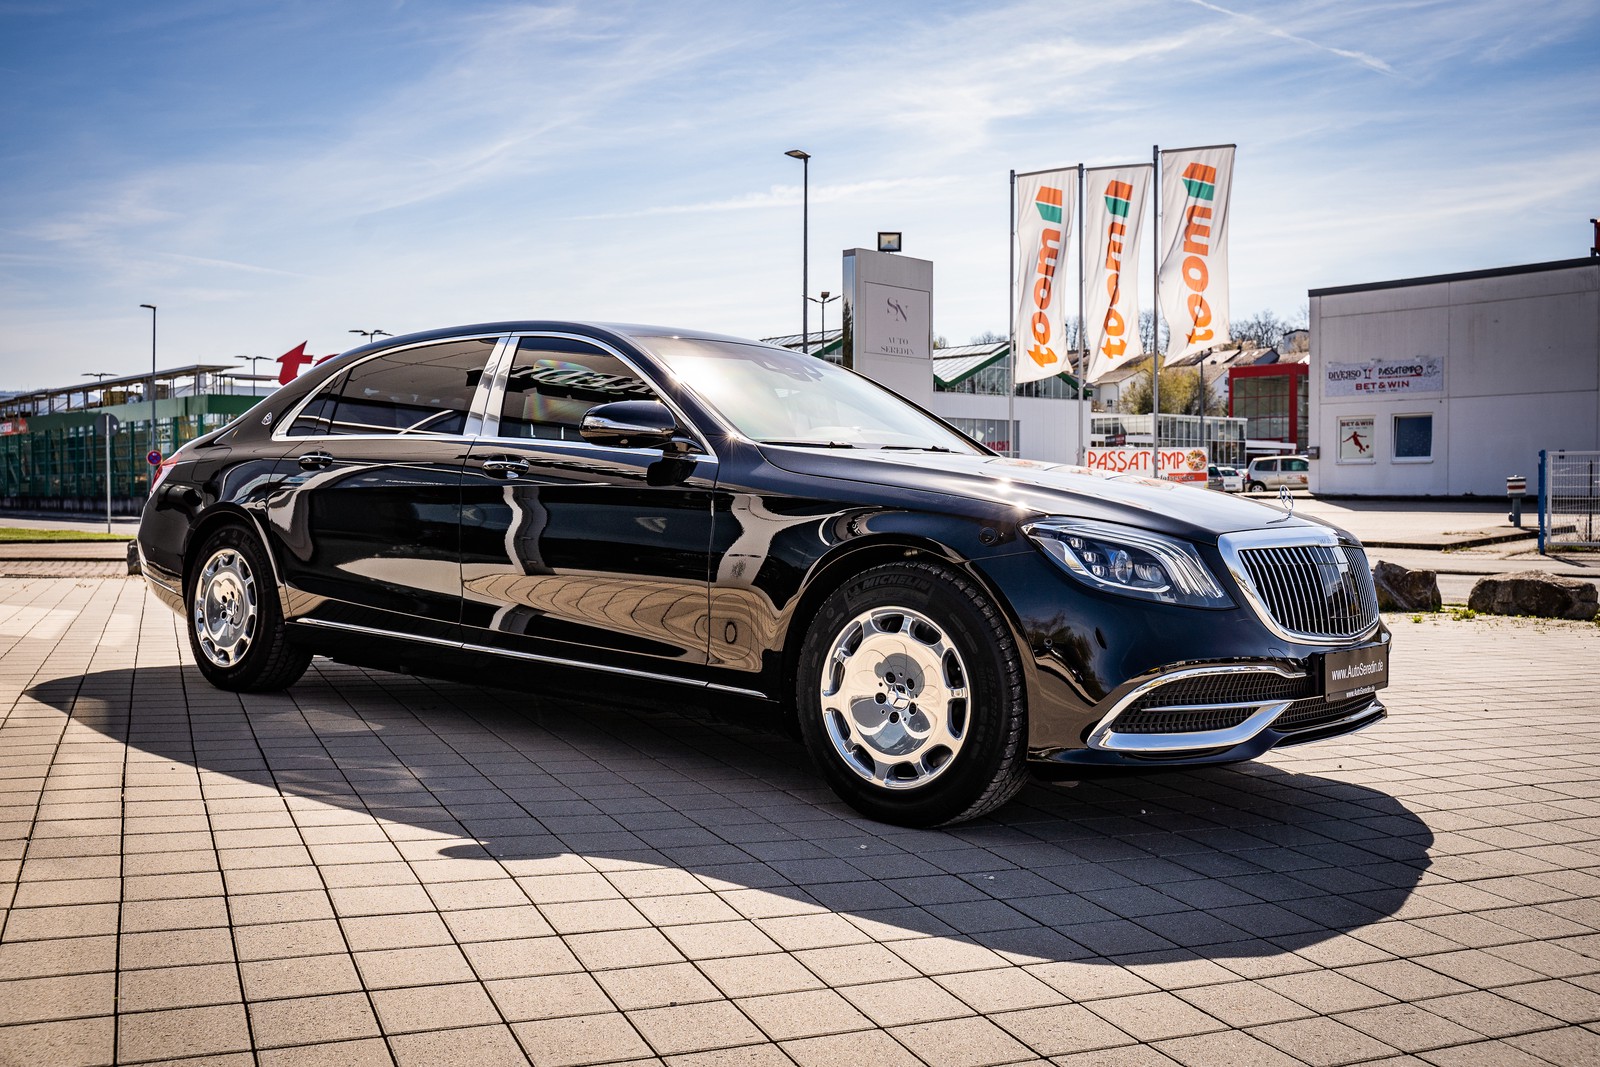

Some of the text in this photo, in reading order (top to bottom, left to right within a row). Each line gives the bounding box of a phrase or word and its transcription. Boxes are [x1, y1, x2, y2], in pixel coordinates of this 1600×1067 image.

[1181, 204, 1215, 345] toom
[1027, 228, 1061, 368] toom
[1101, 220, 1128, 360] toom
[880, 345, 914, 356] SEREDIN
[888, 336, 909, 345] AUTO
[862, 574, 931, 590] MICHELIN
[1331, 659, 1384, 681] www.AutoSeredin.de
